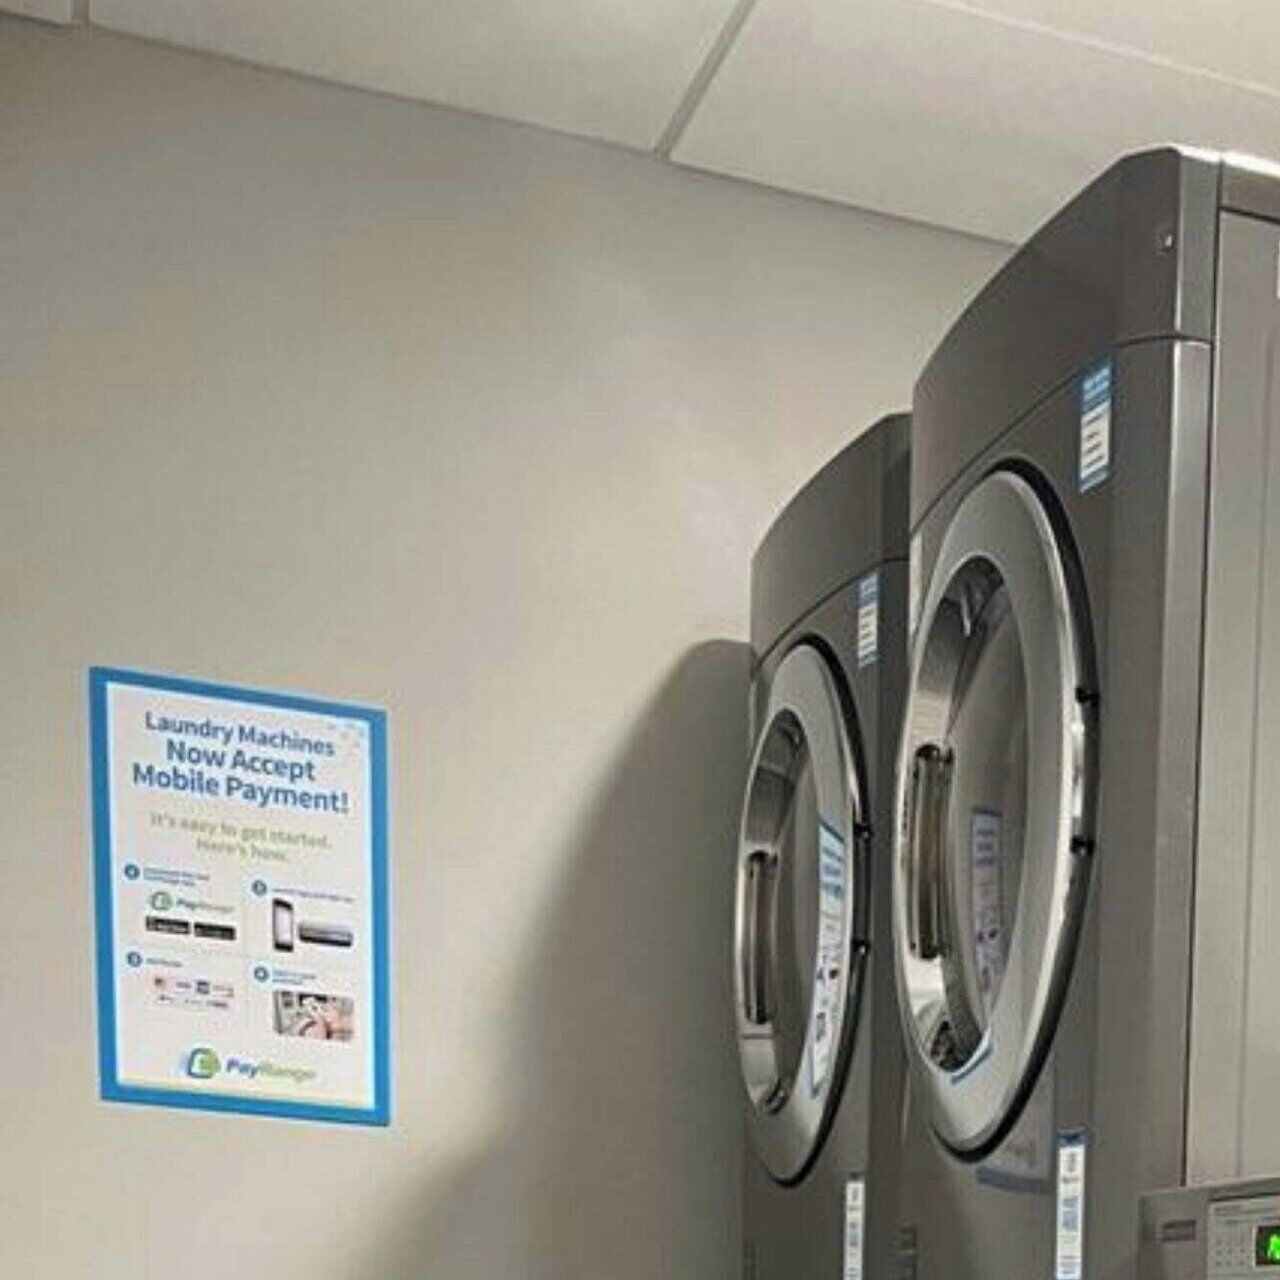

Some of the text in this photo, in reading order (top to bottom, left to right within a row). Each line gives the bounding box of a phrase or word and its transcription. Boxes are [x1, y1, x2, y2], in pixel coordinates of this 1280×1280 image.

[145, 711, 335, 757] Laundry Machines
[166, 738, 315, 783] Now Accept
[132, 762, 348, 814] Mobile Payment!
